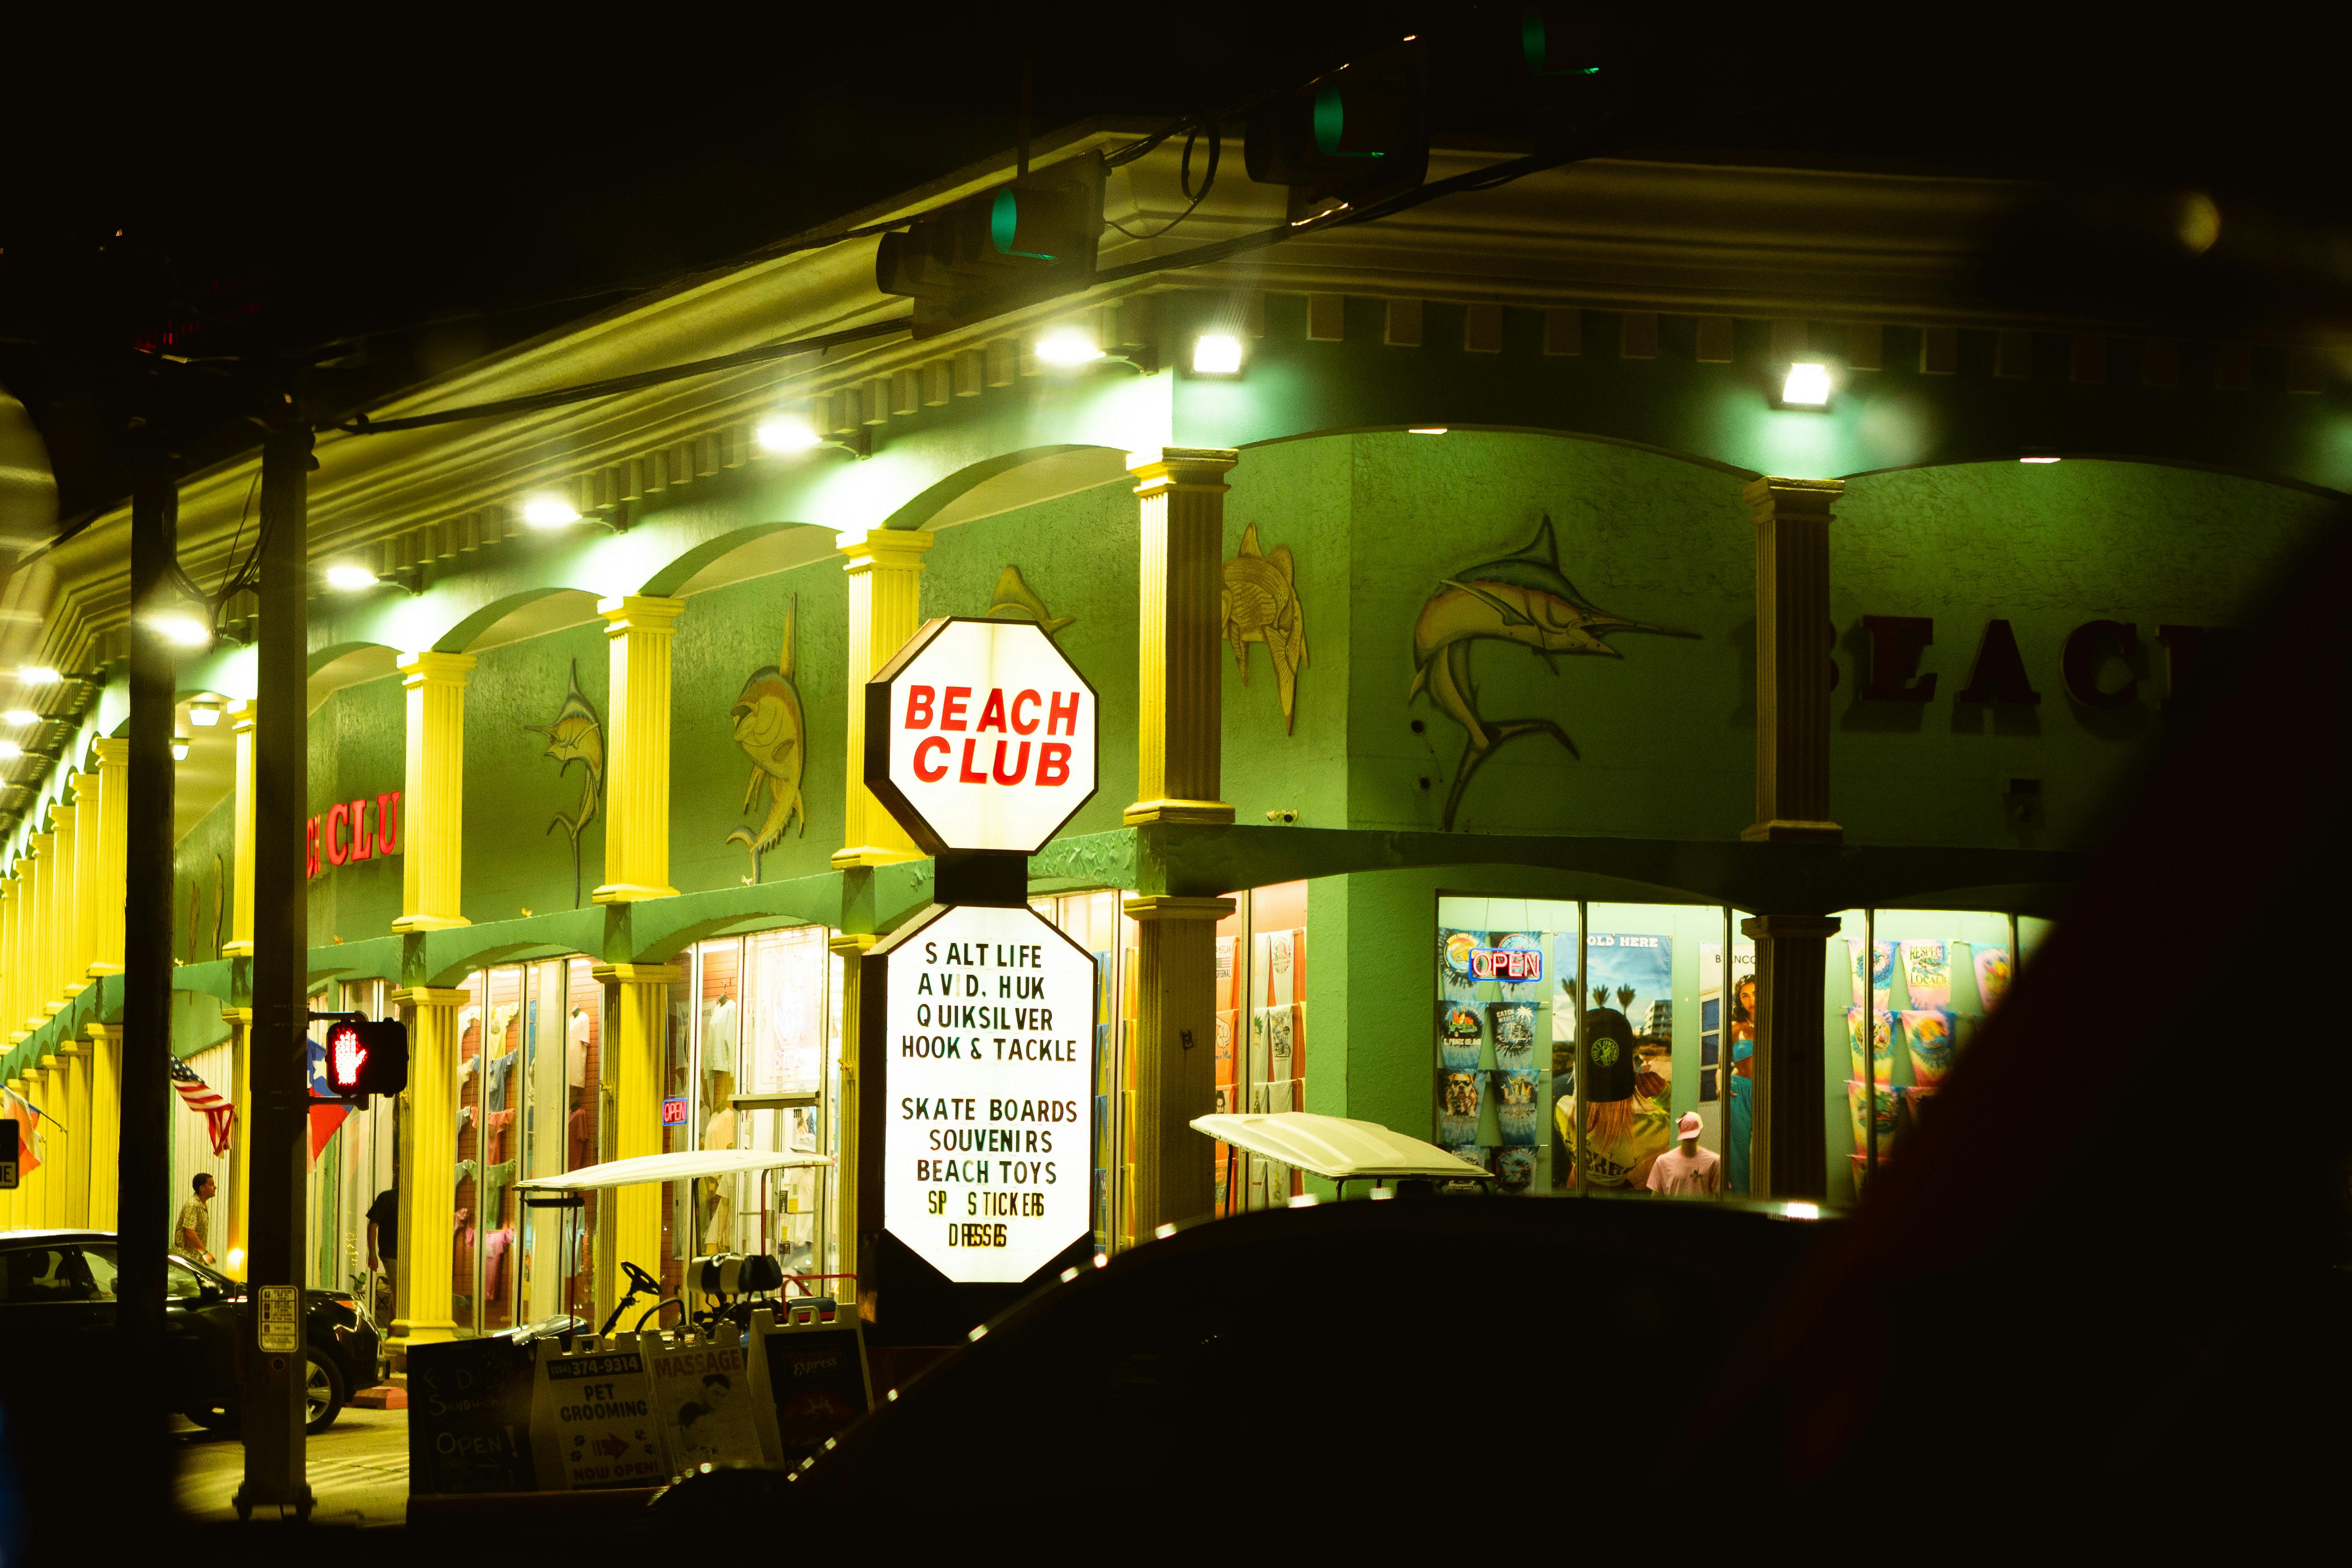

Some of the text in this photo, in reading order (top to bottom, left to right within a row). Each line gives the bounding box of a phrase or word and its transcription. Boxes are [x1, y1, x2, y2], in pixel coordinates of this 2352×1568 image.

[1830, 615, 2243, 710] EAC
[905, 685, 1080, 736] BEACH
[913, 736, 1072, 787] CLUB
[326, 791, 404, 866] CLU
[1586, 936, 1658, 947] OLD HERE
[925, 942, 1041, 968] SALT LIFE
[1472, 951, 1541, 977] OPEN
[999, 976, 1045, 999] HUK
[917, 1003, 1053, 1031] QUIKSILVER
[902, 1035, 1076, 1061] HOOK & TACKLE
[664, 1102, 686, 1122] OPEN
[901, 1097, 1077, 1122] SKATE BOARDS
[929, 1129, 1052, 1153] SOUVENIRS
[917, 1160, 1056, 1184] BEACH TOYS
[572, 1357, 639, 1376] 374-9314
[654, 1349, 741, 1379] MASSAGE
[584, 1383, 614, 1401] PET
[560, 1400, 648, 1422] GROOMING
[573, 1466, 610, 1481] NOW
